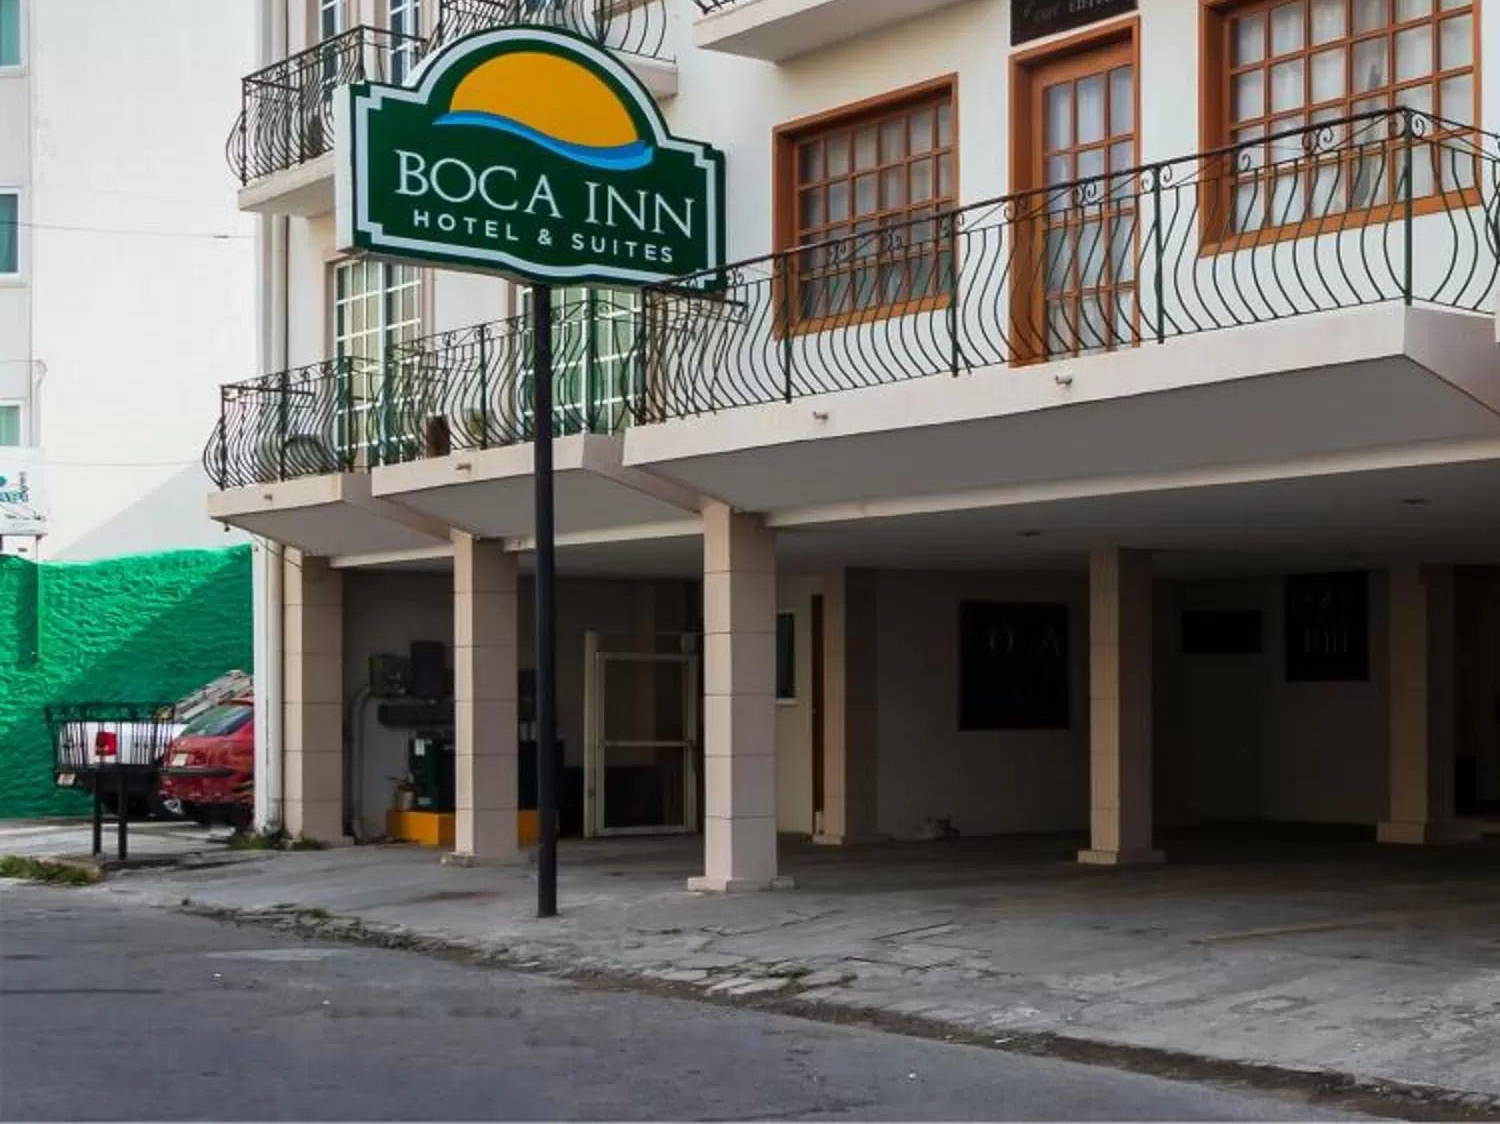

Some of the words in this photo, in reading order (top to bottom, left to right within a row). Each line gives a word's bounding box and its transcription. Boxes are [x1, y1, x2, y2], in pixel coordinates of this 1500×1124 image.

[394, 150, 563, 219] BOCA
[584, 181, 695, 239] INN
[413, 209, 520, 242] HOTEL
[538, 228, 553, 247] &
[571, 232, 674, 264] SUITES
